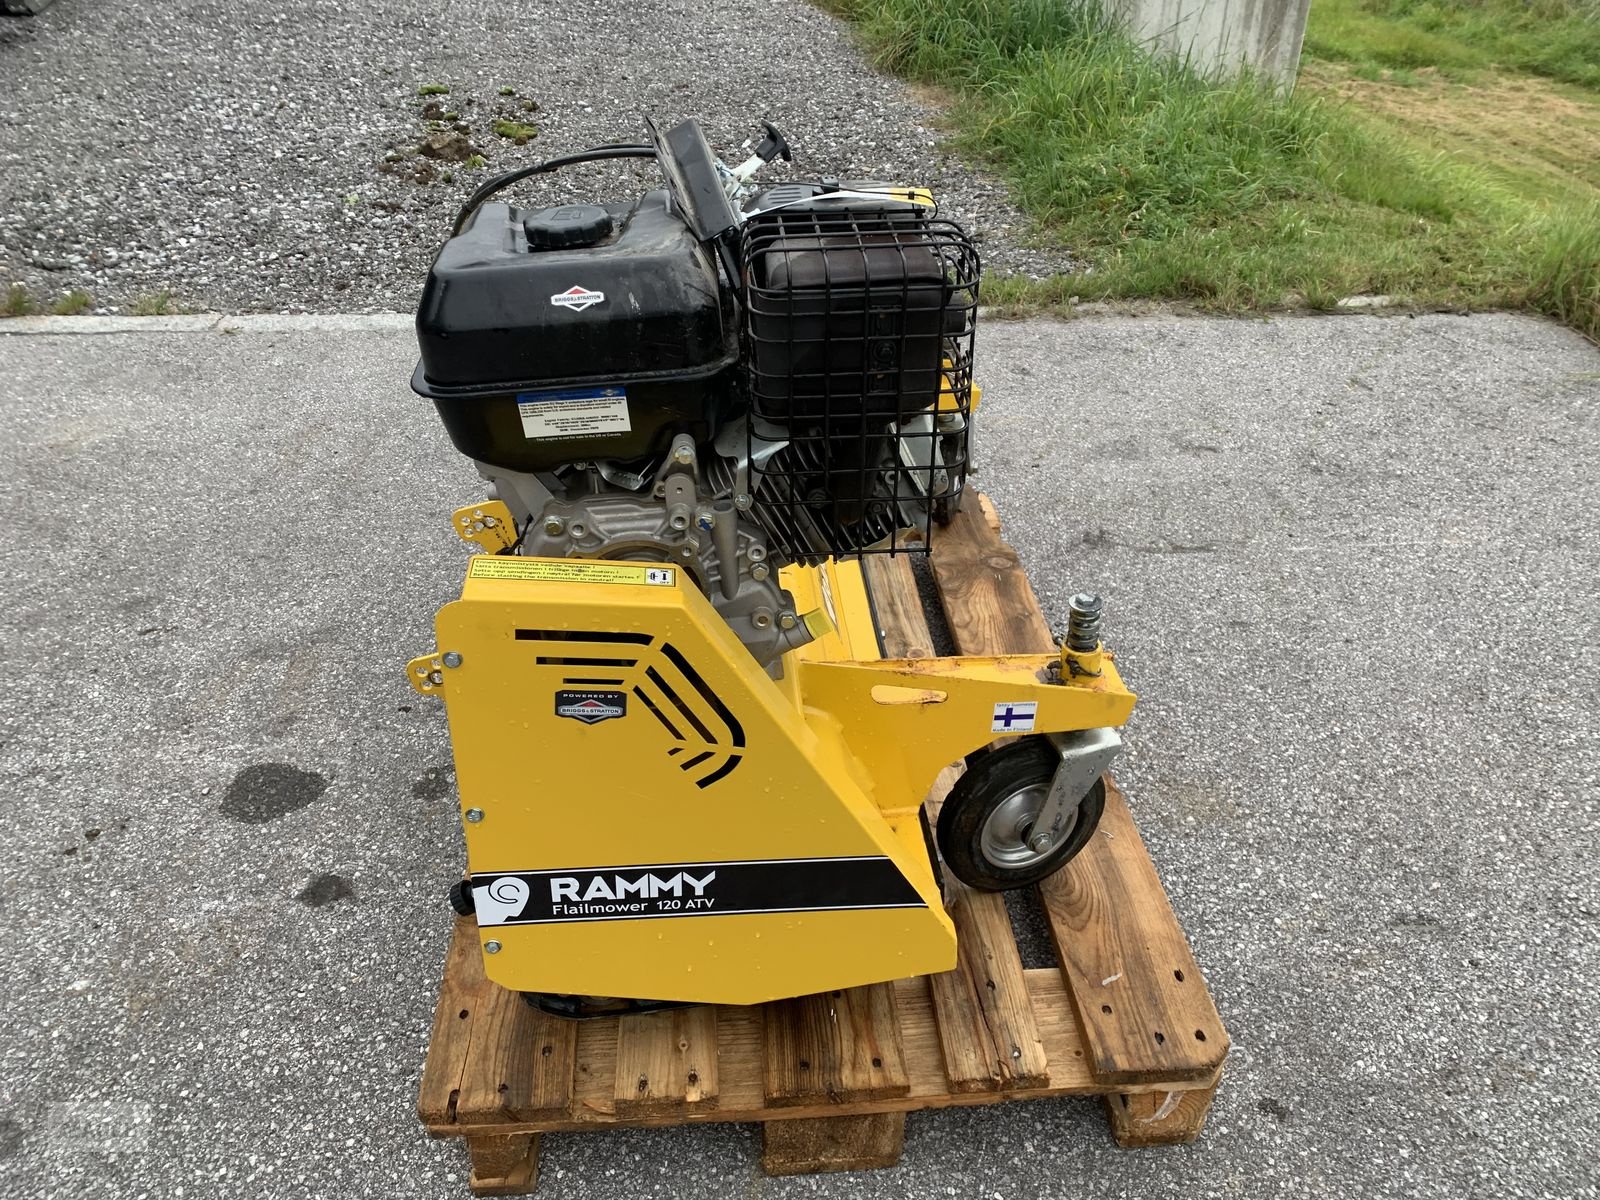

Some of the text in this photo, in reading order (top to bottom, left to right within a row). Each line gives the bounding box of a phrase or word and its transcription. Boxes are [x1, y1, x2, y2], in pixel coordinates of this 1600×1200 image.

[550, 870, 716, 902] RAMMY
[552, 898, 715, 916] Flailmower 120 ATV
